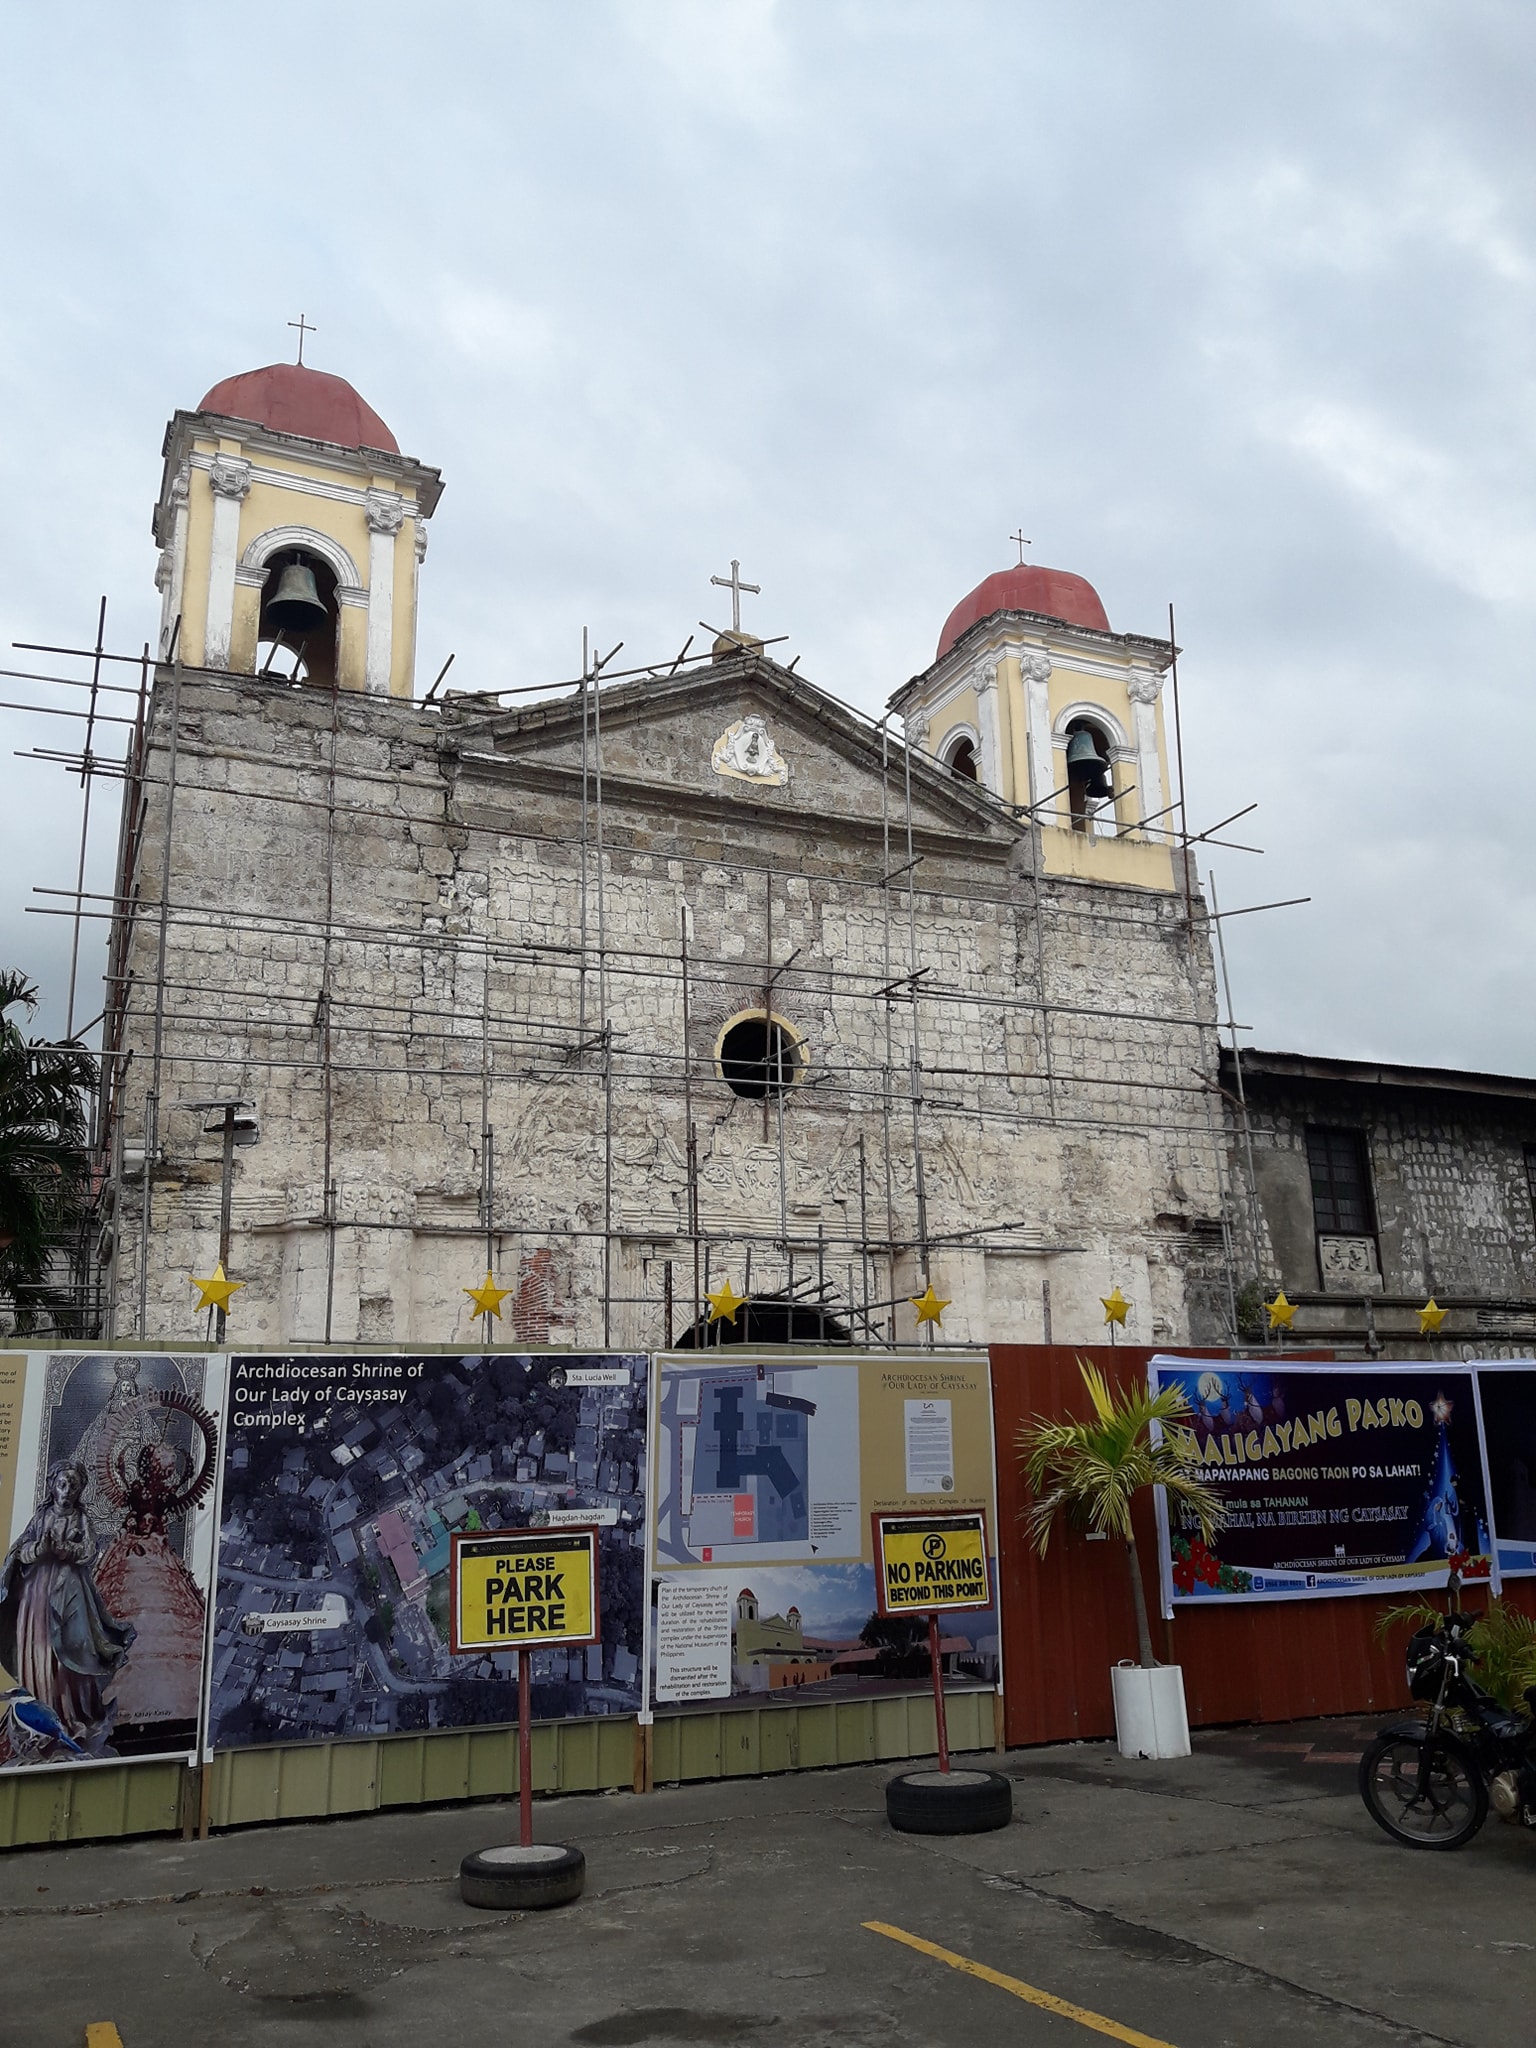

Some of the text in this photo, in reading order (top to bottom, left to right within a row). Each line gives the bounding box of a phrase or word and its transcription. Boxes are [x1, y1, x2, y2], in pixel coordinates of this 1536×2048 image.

[236, 1362, 425, 1379] Archdiocesan Shrine of
[603, 1373, 617, 1381] Well
[235, 1386, 407, 1405] Our Lady of Caysasay
[233, 1411, 306, 1430] Complex
[1178, 1398, 1424, 1467] MALIGAYANG PASKO
[1196, 1467, 1270, 1481] MAPAYAPANG
[1272, 1467, 1319, 1480] BAGONG
[1321, 1466, 1349, 1479] TAON
[1352, 1466, 1367, 1478] PO
[1369, 1465, 1383, 1477] SA
[1385, 1464, 1421, 1477] LAHAT!
[1226, 1498, 1248, 1508] mula
[1250, 1500, 1261, 1508] sa
[1263, 1497, 1309, 1508] TAHANAN
[553, 1513, 606, 1523] Hagdan-hagdan
[1257, 1512, 1277, 1527] NA
[1278, 1509, 1327, 1525] BIRHEN
[1330, 1508, 1349, 1522] NG
[1352, 1506, 1409, 1522] CAYSASAY
[496, 1557, 555, 1574] PLEASE
[887, 1557, 983, 1584] NO PARKING
[486, 1574, 565, 1605] PARK
[890, 1582, 983, 1602] BEYOND THIS POINT
[267, 1616, 327, 1627] Caysasay Shrine
[487, 1604, 566, 1635] HERE
